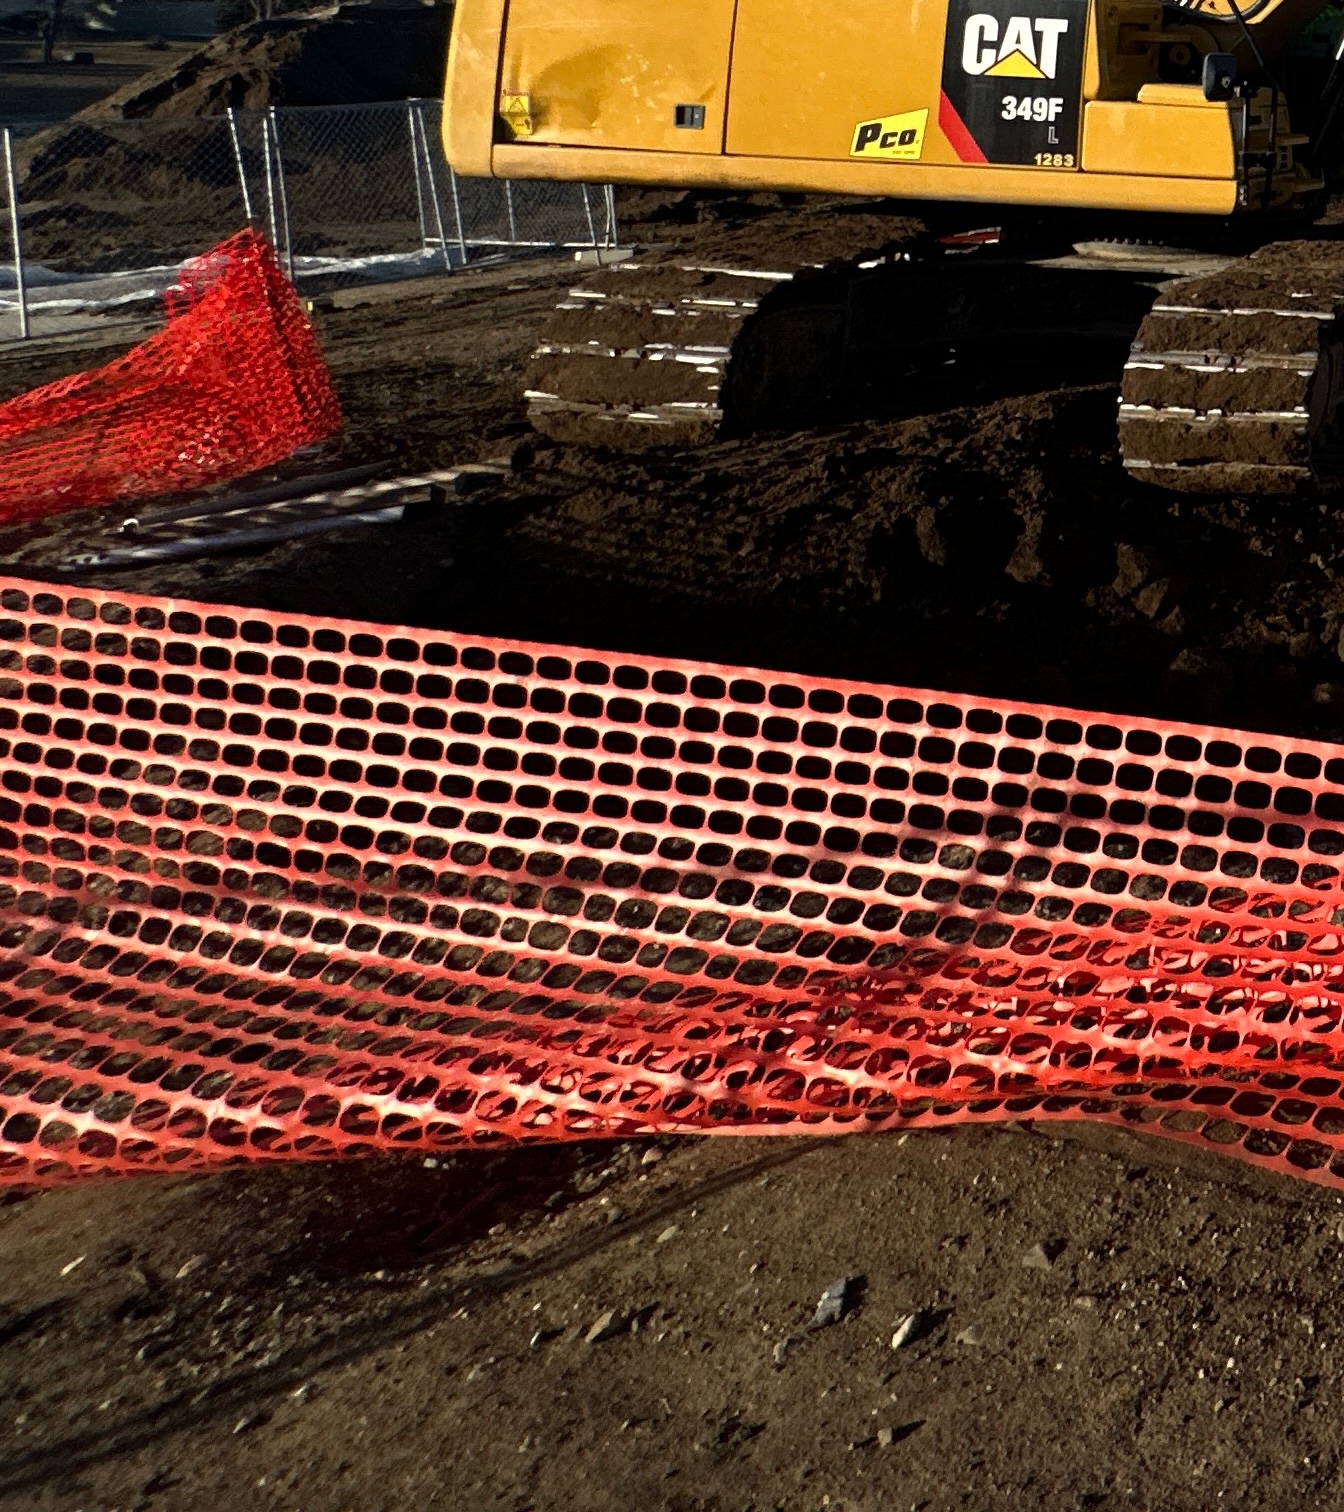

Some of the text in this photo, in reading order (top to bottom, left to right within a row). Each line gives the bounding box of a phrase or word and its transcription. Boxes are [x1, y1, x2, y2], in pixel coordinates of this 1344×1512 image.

[961, 13, 1069, 80] CAT
[1001, 95, 1064, 122] 349F
[1047, 126, 1059, 144] L
[1034, 152, 1075, 167] 1283
